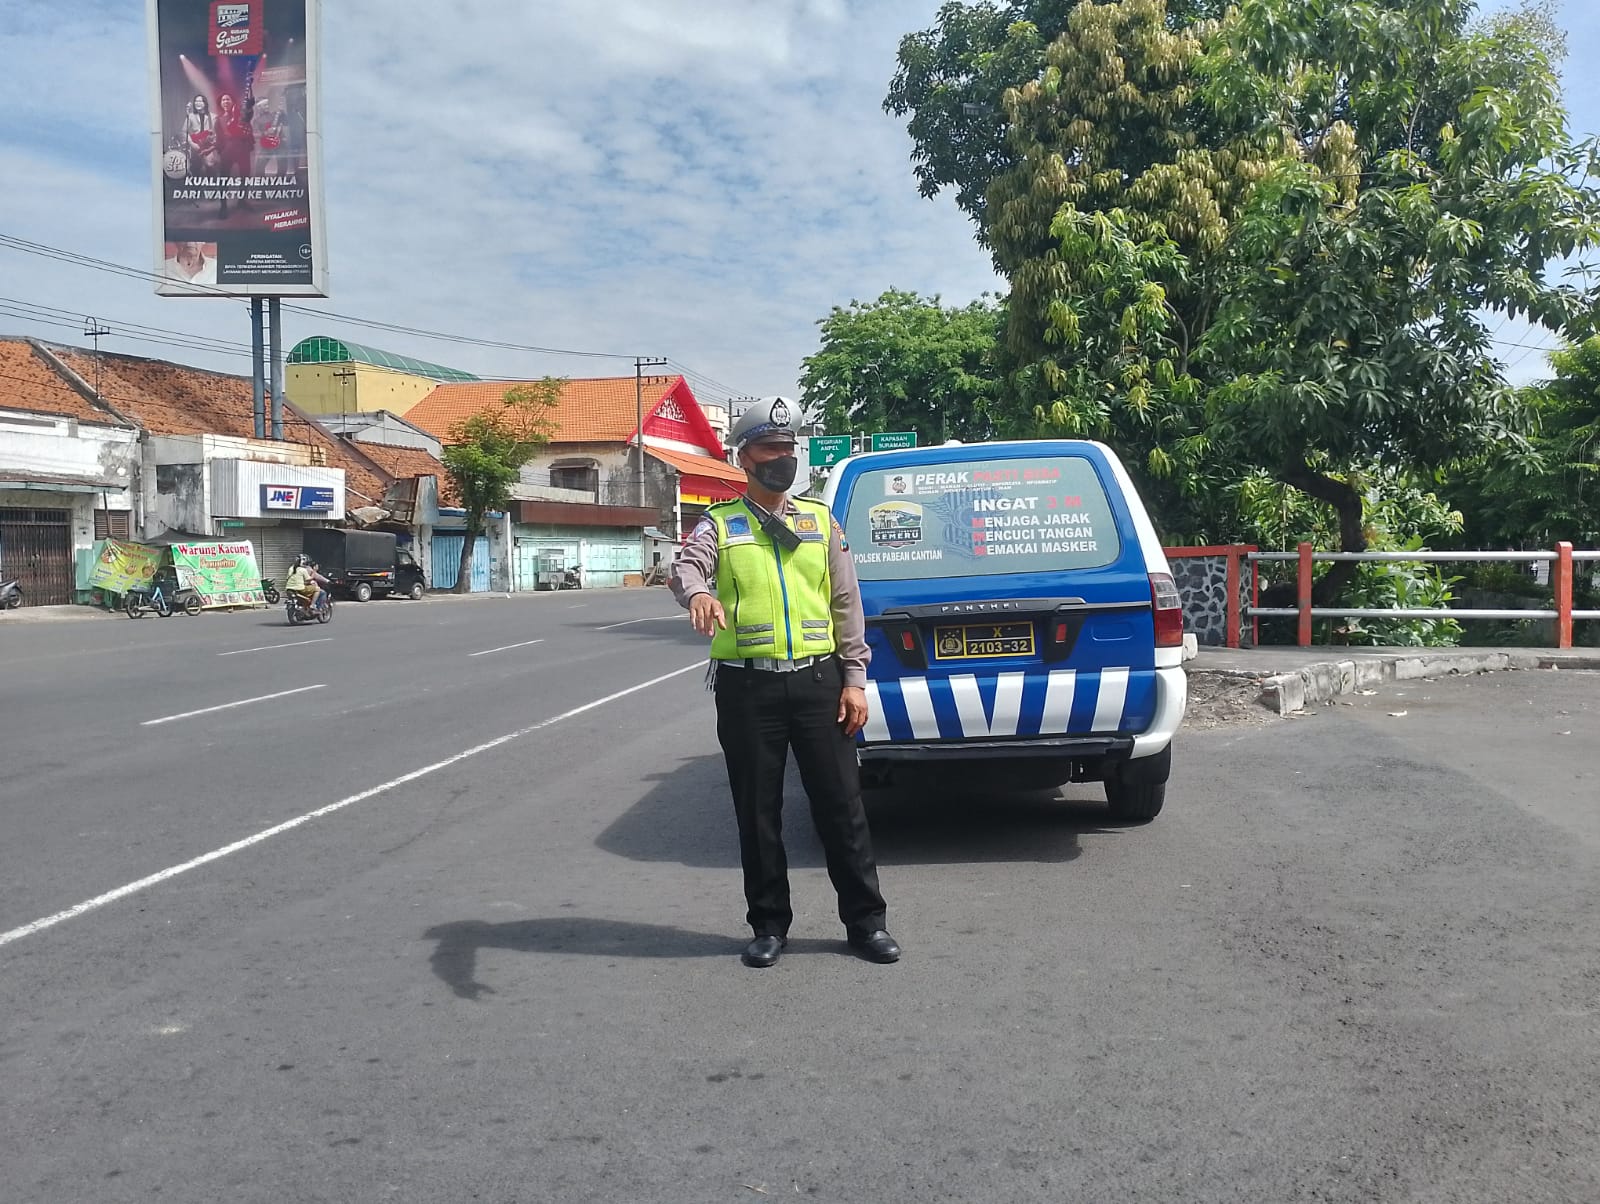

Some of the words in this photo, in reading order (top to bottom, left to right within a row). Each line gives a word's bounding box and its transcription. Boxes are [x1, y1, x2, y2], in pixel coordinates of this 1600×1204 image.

[185, 176, 242, 186] KUALITAS
[245, 176, 297, 186] MENYALA
[173, 190, 200, 199] DARI
[204, 190, 245, 199] WAKTU
[247, 190, 262, 199] KE
[265, 189, 304, 199] WAKTU
[265, 210, 298, 221] NYALAKAN
[915, 471, 969, 486] PERAK
[973, 470, 1018, 481] PASTI
[269, 490, 295, 502] JNE
[973, 497, 1039, 512] INGAT
[971, 515, 1040, 529] MENJAGA
[1043, 513, 1091, 525] JARAK
[874, 531, 919, 540] SEMERU
[972, 529, 1035, 543] MENCUCI
[1038, 527, 1093, 540] TANGAN
[178, 544, 216, 556] Warung
[217, 543, 251, 555] Kacung
[973, 543, 1038, 556] MEMAKAI
[1041, 541, 1099, 553] MASKER
[854, 552, 881, 564] POLSEK
[882, 551, 910, 562] PABEAN
[911, 550, 943, 561] CANTIAN
[994, 628, 1002, 637] X
[970, 640, 1028, 654] 2103-32
